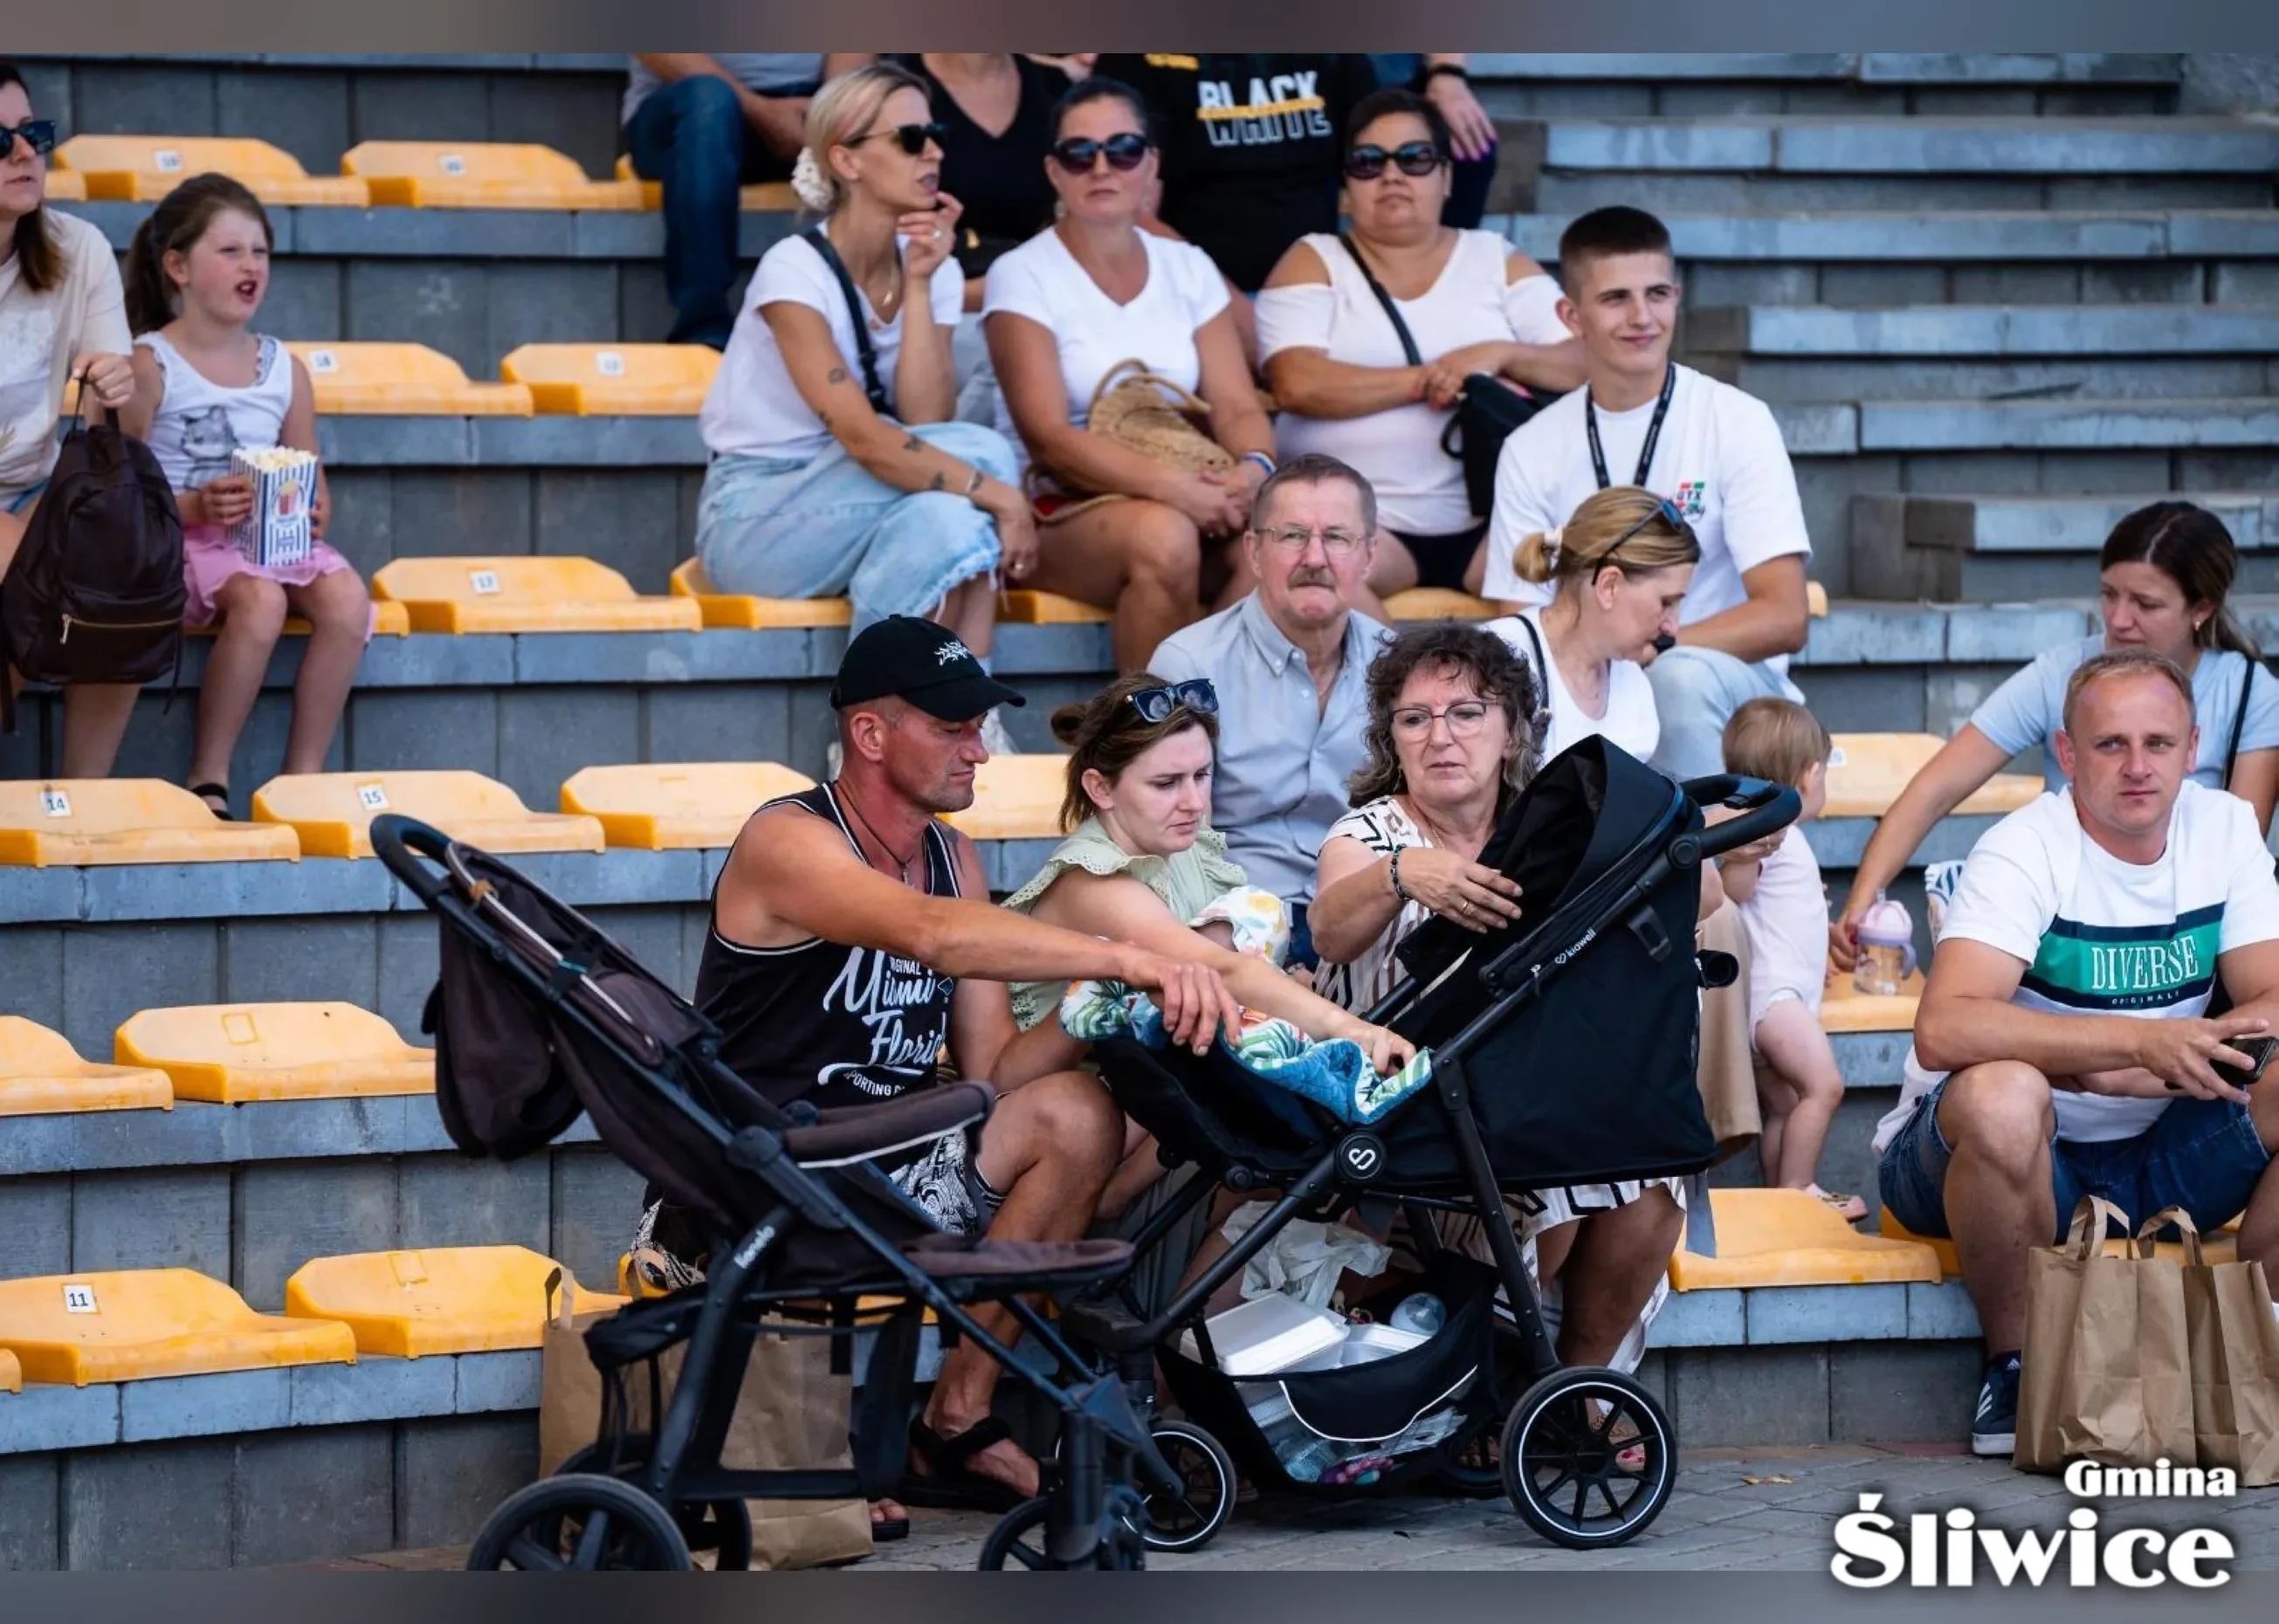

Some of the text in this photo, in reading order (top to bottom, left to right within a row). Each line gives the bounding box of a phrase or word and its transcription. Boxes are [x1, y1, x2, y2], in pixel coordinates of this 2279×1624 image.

[1197, 70, 1319, 110] BLACK
[47, 797, 66, 811] 14
[364, 790, 382, 804] 15
[2090, 934, 2199, 990] DIVERSE
[861, 1009, 947, 1066] Florid
[68, 1292, 89, 1307] 11
